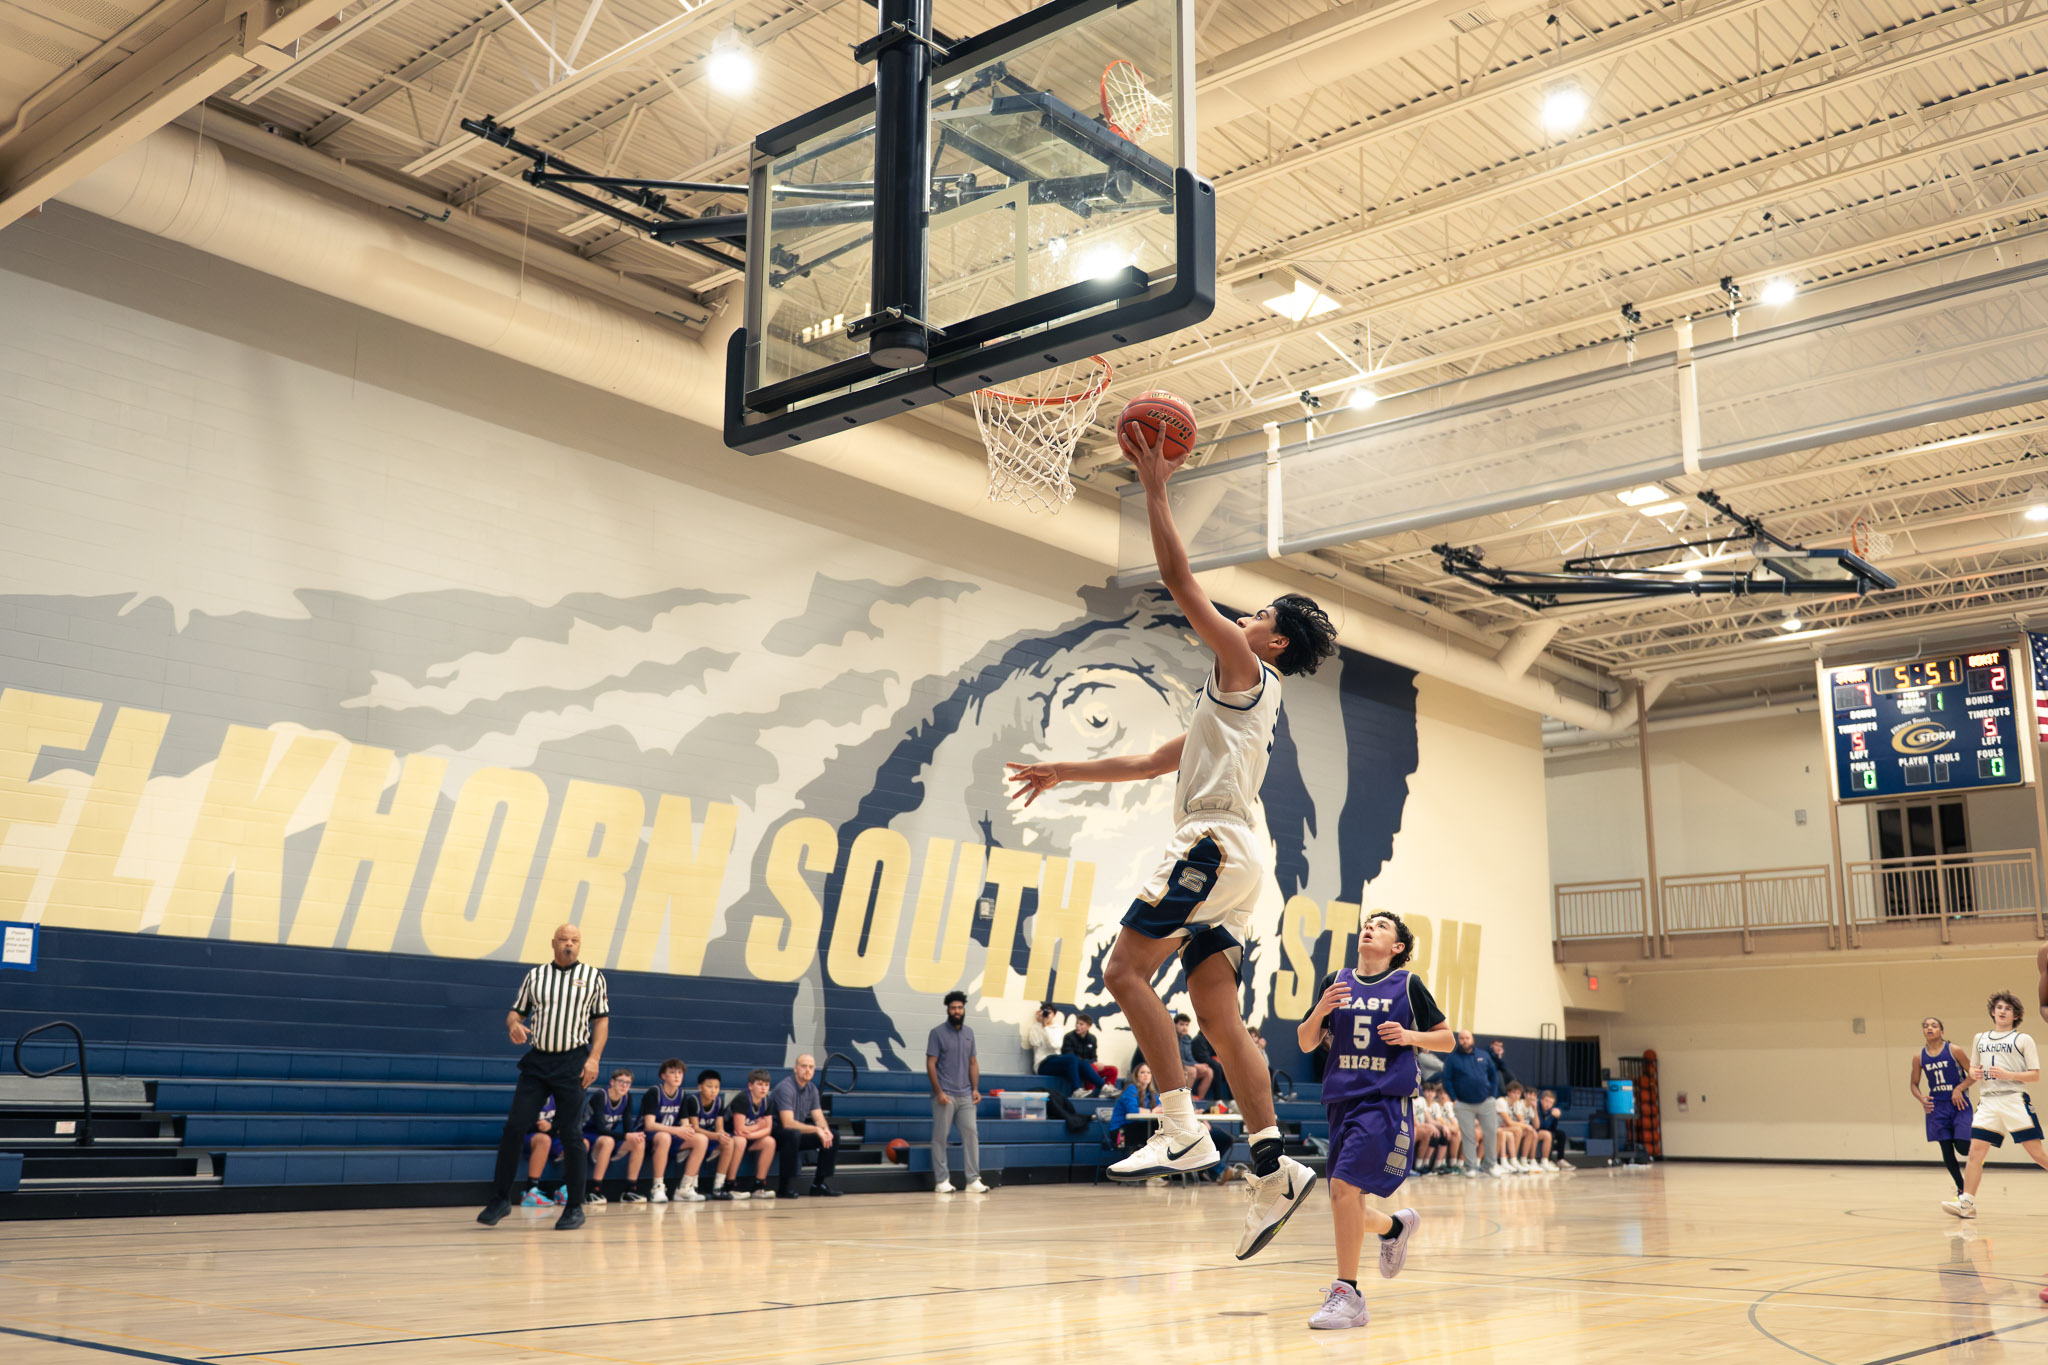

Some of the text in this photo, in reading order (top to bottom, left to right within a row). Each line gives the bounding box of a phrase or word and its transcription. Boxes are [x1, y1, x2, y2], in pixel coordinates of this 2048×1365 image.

[1894, 660, 1956, 689] 5:51
[1990, 667, 2006, 691] 2
[1855, 683, 1872, 707] 7
[1936, 692, 1944, 711] 1
[1965, 694, 1994, 706] BONUS
[1968, 706, 2011, 719] TIMEOUTS
[1837, 721, 1878, 735] TIMEOUTS
[1912, 717, 1931, 725] South
[1983, 717, 1998, 737] 5
[1851, 731, 1865, 751] 5
[1919, 730, 1956, 743] STORM
[1981, 735, 2002, 746] LEFT
[1849, 749, 1869, 760] LEFT
[1898, 752, 1960, 767] PLAYER FOULS
[1976, 748, 2004, 758] FOULS
[1850, 761, 1876, 772] FOULS
[1991, 757, 2005, 776] 0
[1863, 770, 1877, 790] 0
[745, 817, 1096, 1004] SOUTH
[1352, 1015, 1372, 1050] 5
[1978, 1043, 2013, 1053] ELKHORN
[1338, 1055, 1387, 1072] HIGH
[1925, 1060, 1948, 1071] EAST
[1934, 1069, 1946, 1085] 11
